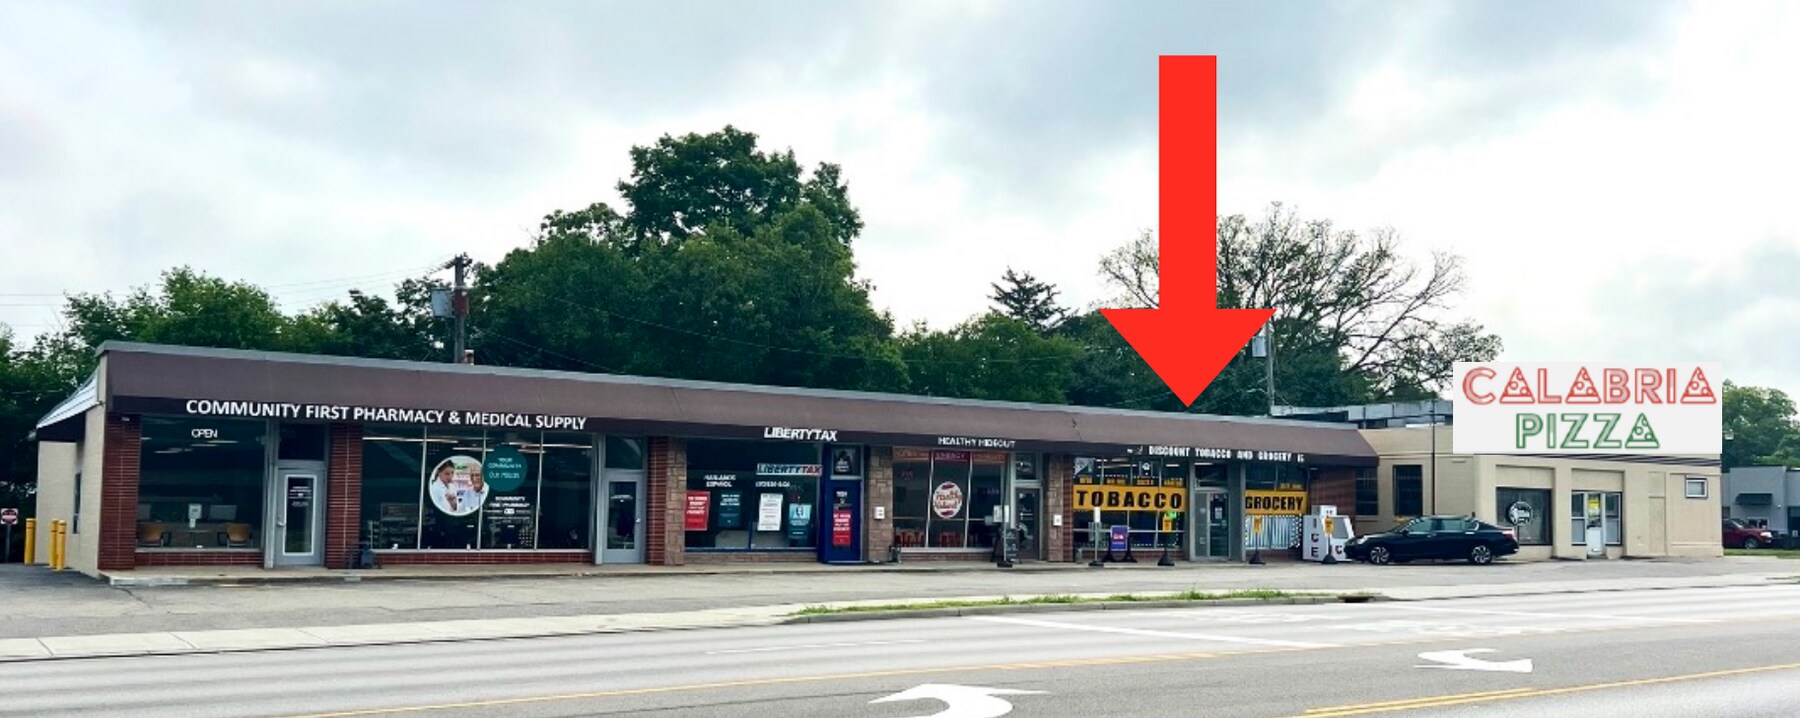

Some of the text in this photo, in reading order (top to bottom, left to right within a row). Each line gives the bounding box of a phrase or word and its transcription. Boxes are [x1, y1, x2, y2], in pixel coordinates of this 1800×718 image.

[186, 399, 586, 430] COMMUNITY FIRST PHARMACY & MEDICAL SUPPLY
[190, 428, 218, 439] OPEN
[938, 438, 1016, 448] HEALTHY HIDEOUT
[1148, 445, 1190, 457] DISCOUNT
[1195, 447, 1232, 459] TOBACCO
[1237, 449, 1253, 460] AND
[1258, 450, 1292, 462] GROCERY
[1076, 490, 1182, 509] TOBACCO
[1245, 495, 1304, 511] GROCERY
[1311, 518, 1320, 558] ICE
